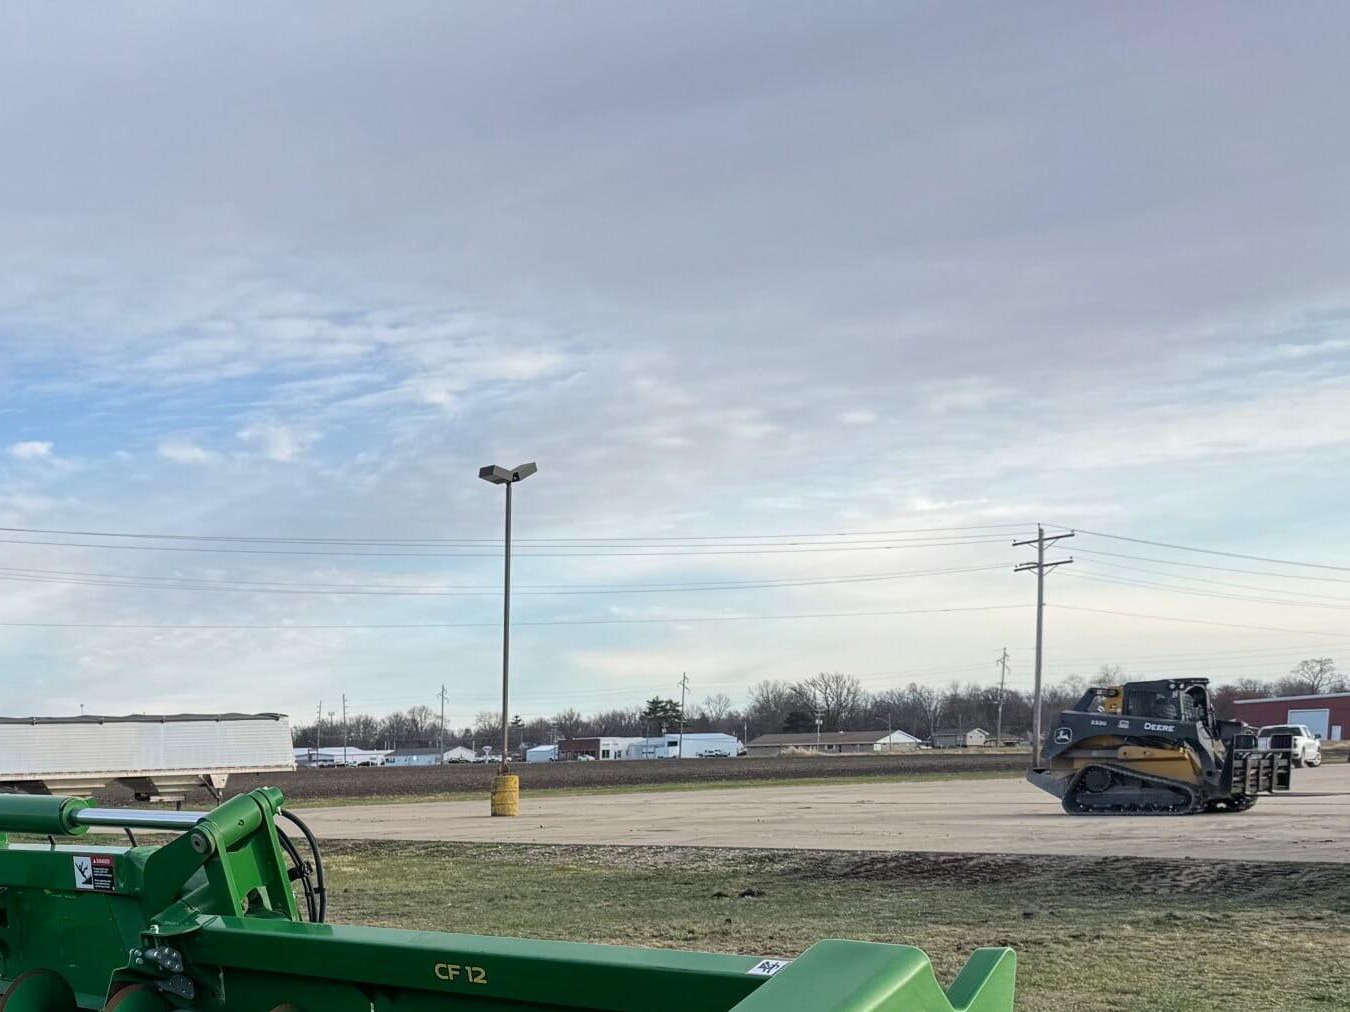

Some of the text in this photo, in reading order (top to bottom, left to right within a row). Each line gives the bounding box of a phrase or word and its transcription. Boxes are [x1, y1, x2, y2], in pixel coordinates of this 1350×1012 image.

[1143, 722, 1175, 732] DEERE
[434, 963, 488, 984] CF 12
